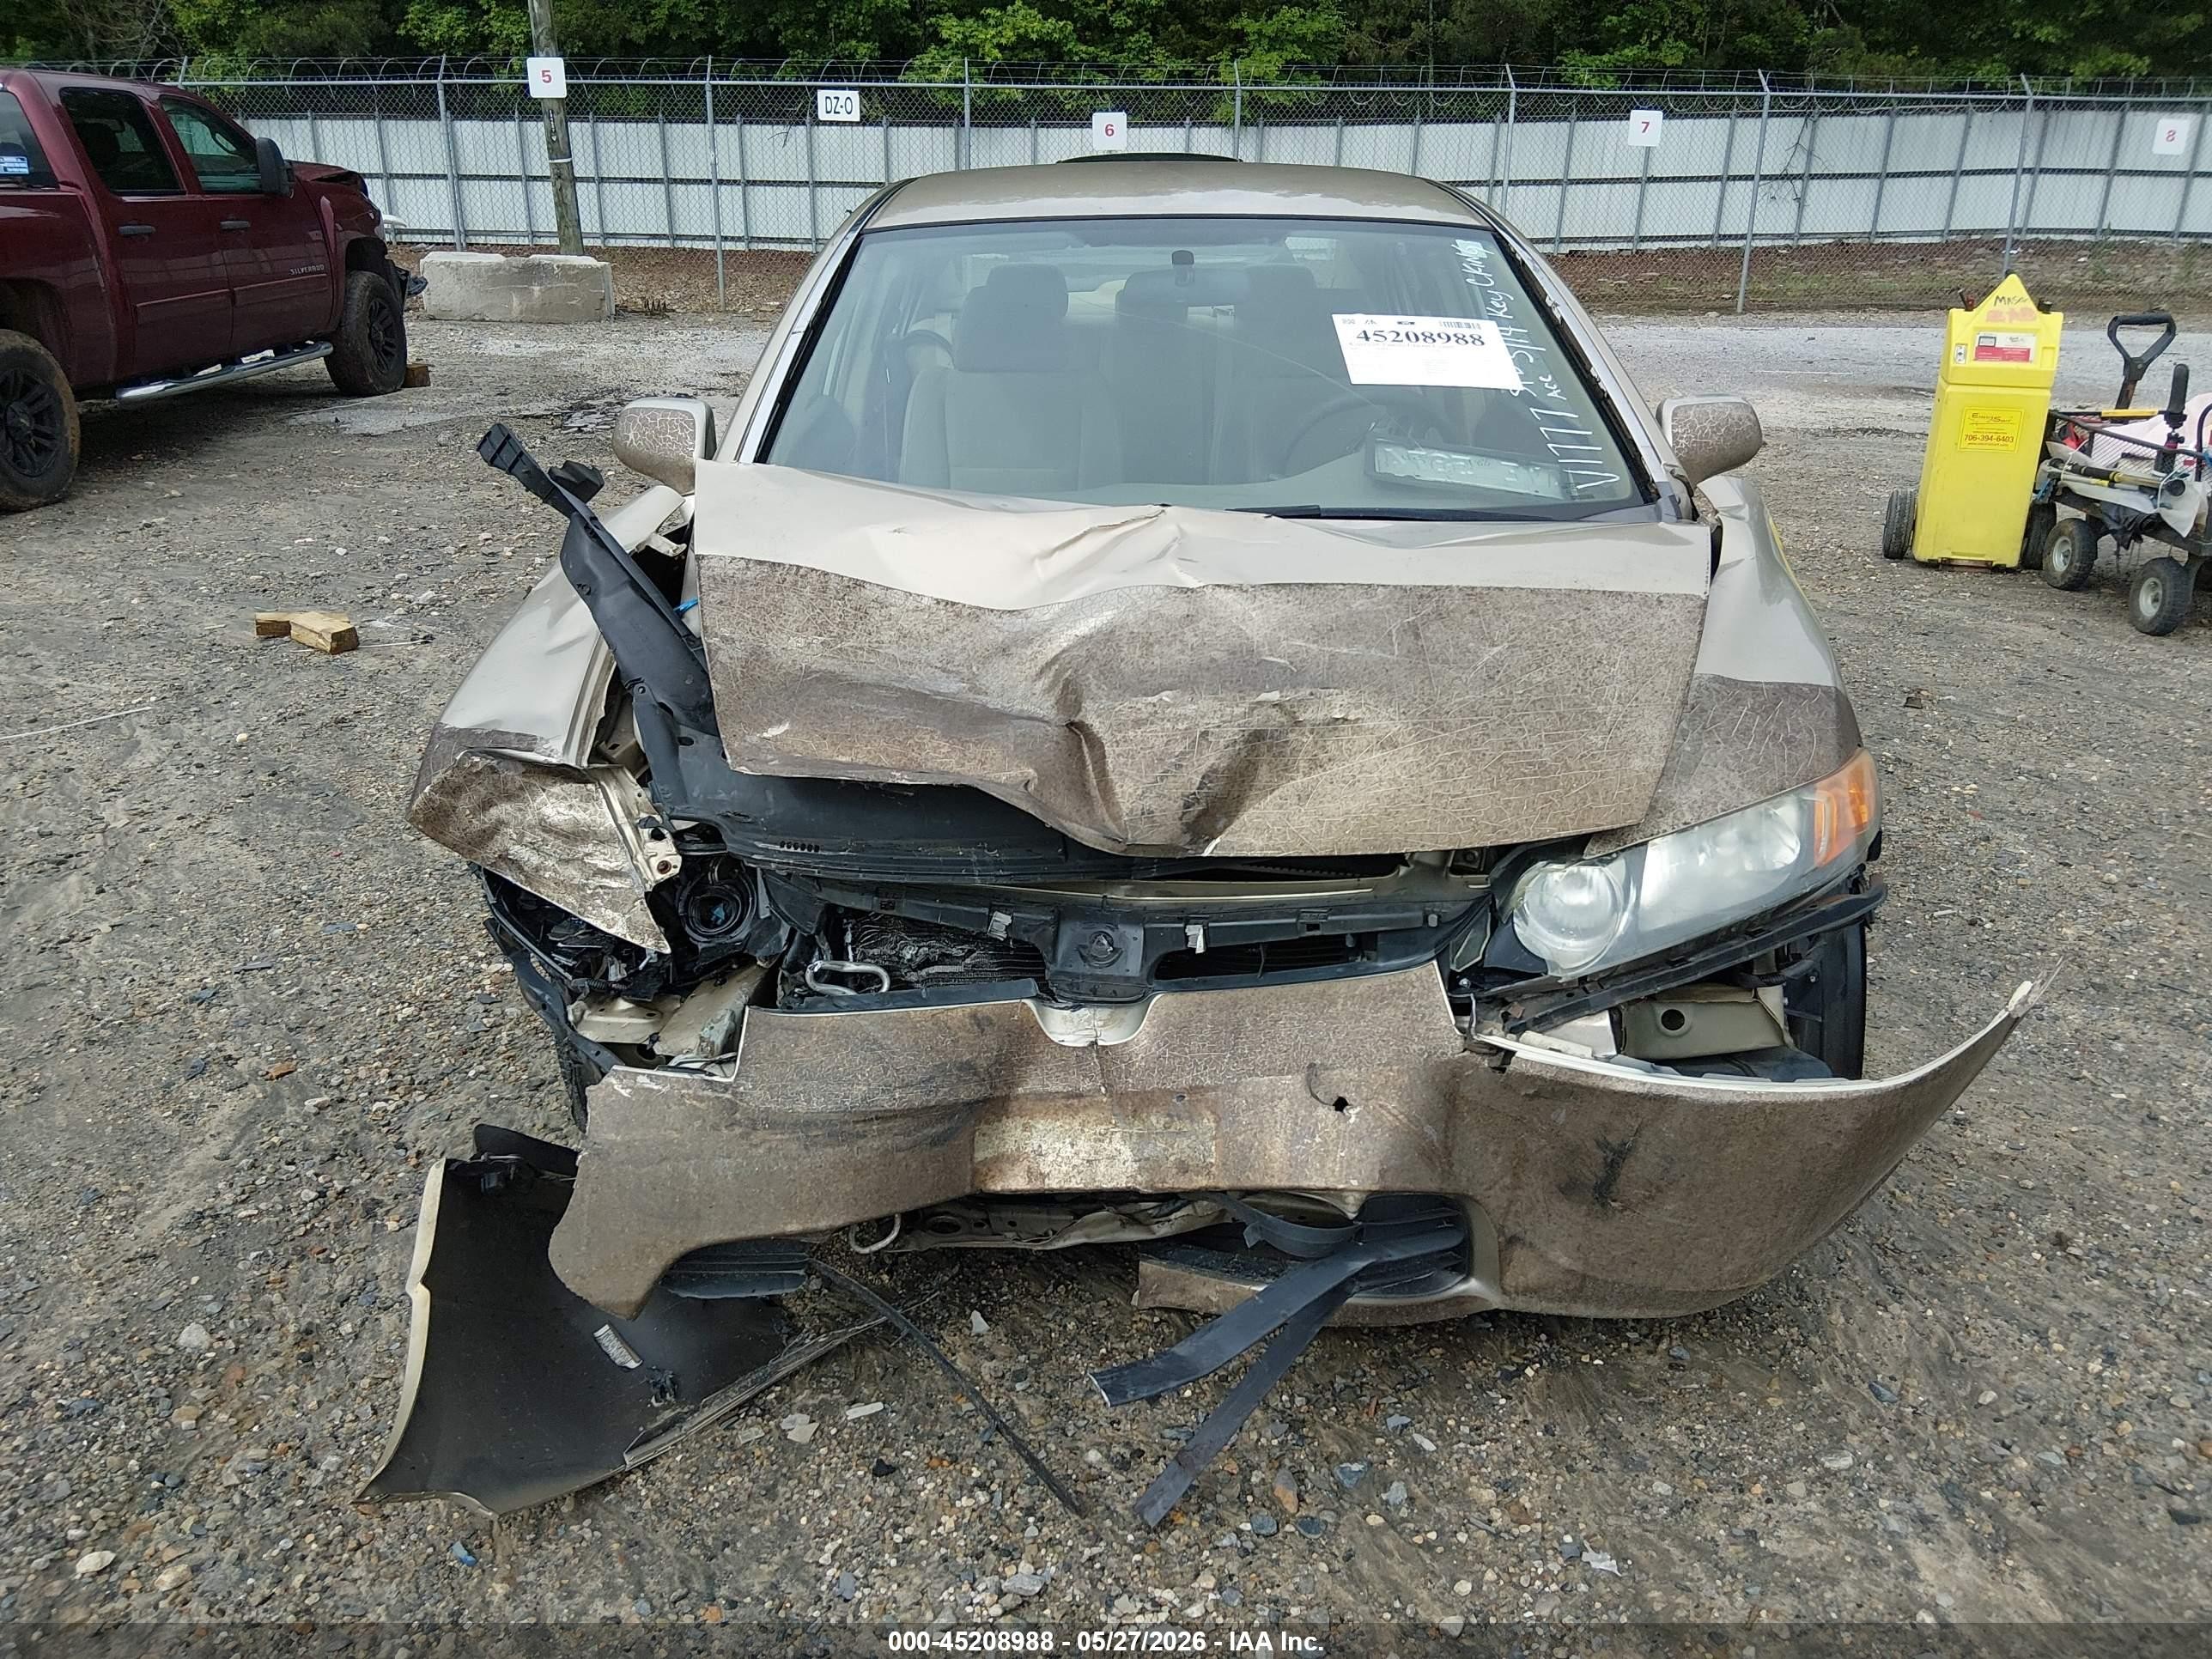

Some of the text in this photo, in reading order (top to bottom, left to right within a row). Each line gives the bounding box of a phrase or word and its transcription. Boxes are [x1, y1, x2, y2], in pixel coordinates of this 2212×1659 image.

[541, 70, 552, 83] 5
[1104, 123, 1115, 137] 6
[1641, 121, 1650, 133] 7
[2166, 130, 2177, 143] 8
[289, 264, 325, 276] SILVERADO
[1356, 329, 1485, 347] 45208988
[1964, 434, 2014, 443] 706-394-6403
